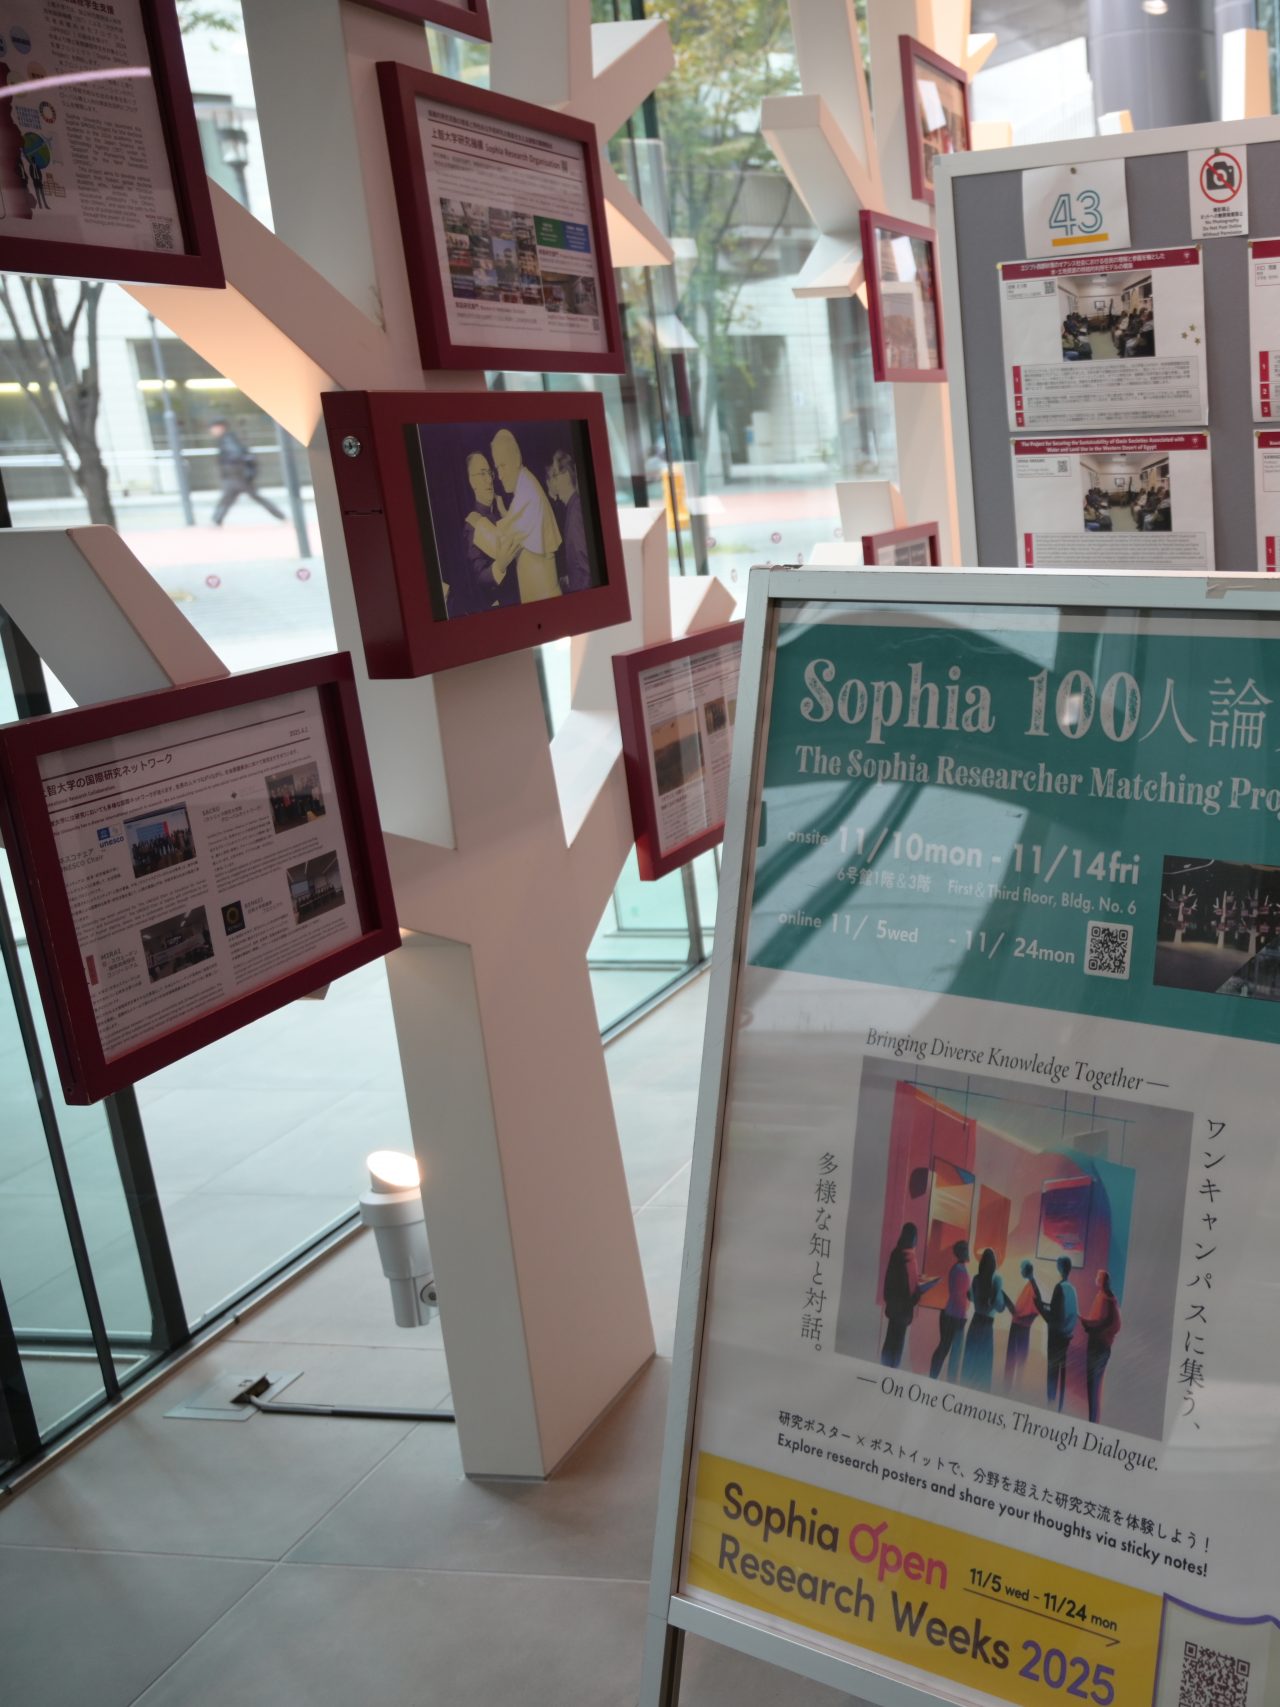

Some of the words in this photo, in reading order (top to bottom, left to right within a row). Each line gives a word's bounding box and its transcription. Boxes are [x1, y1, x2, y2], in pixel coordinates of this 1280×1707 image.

[1049, 190, 1102, 236] 43
[800, 658, 996, 744] Sophia
[795, 745, 842, 776] The
[846, 749, 930, 787] Sophia
[936, 755, 1084, 795] Researcher
[1090, 766, 1224, 816] Matching
[100, 836, 124, 848] unesco
[787, 829, 829, 846] onsite
[1014, 843, 1140, 885] 11/14fri
[778, 910, 822, 928] online
[988, 884, 1020, 902] Third
[1023, 887, 1057, 908] floor,
[1061, 892, 1095, 914] Bldg.
[1099, 897, 1124, 914] No.
[1127, 900, 1136, 916] 6
[866, 1027, 928, 1060] Bringing
[929, 1038, 984, 1065] Diverse
[987, 1047, 1070, 1084] Knowledge
[800, 1152, 839, 1352] 多様な知と対話。
[1180, 1119, 1226, 1430] ワンキャンパスに集う、
[908, 1383, 938, 1408] One
[1012, 1411, 1078, 1450] Through
[1082, 1432, 1158, 1472] Dialogue.
[778, 1433, 824, 1458] Explore
[826, 1450, 878, 1474] research
[882, 1467, 927, 1490] posters
[930, 1482, 956, 1498] and
[959, 1488, 996, 1510] share
[999, 1502, 1030, 1521] your
[1033, 1510, 1092, 1540] thoughts
[1096, 1531, 1117, 1548] via
[1120, 1540, 1160, 1564] sticky
[1164, 1552, 1208, 1578] notes!
[722, 1482, 840, 1553] Sophia
[849, 1521, 948, 1590] Open
[970, 1568, 1002, 1592] 11/5
[1004, 1584, 1030, 1601] wed
[1044, 1592, 1087, 1622] 11/24
[1090, 1614, 1118, 1632] mon
[718, 1532, 875, 1622] Research
[891, 1590, 1010, 1670] Weeks
[1018, 1640, 1115, 1706] 2025
